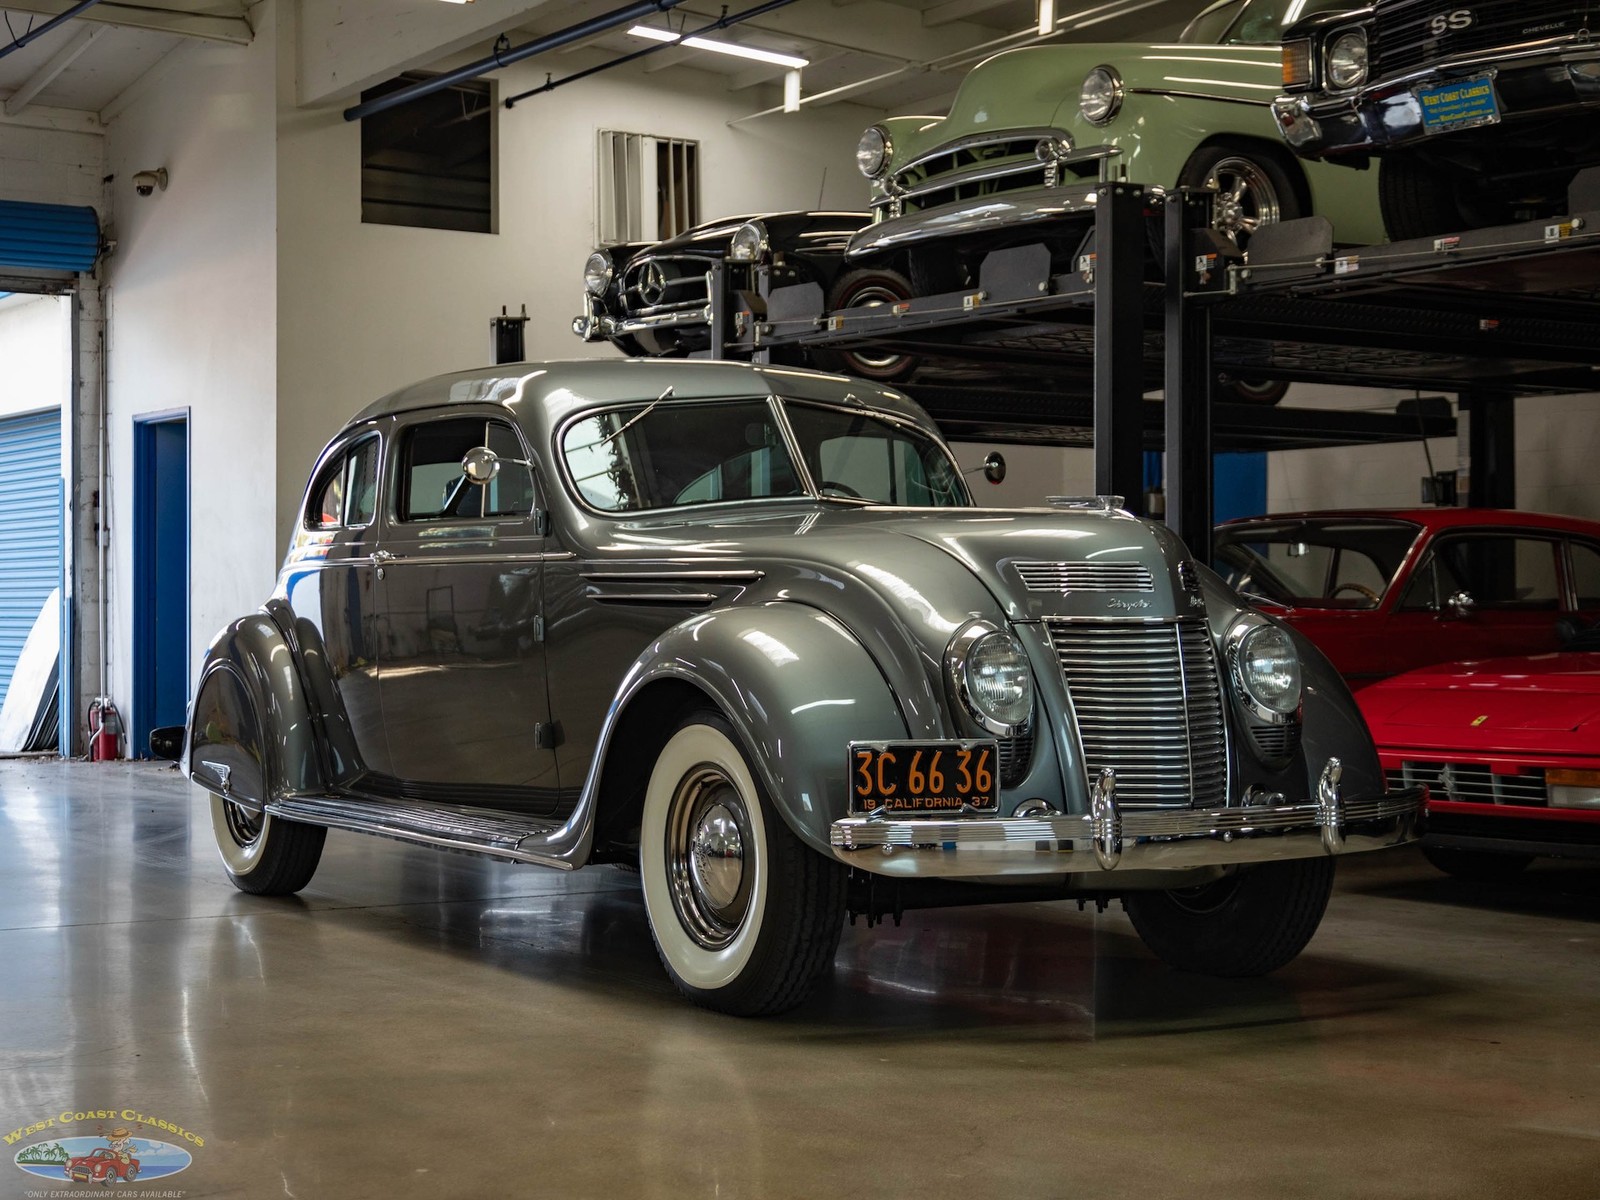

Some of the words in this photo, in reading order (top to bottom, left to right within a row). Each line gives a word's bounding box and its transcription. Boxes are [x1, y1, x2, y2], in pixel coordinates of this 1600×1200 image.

[1431, 9, 1473, 35] SS
[1522, 21, 1566, 34] CHEVELLE
[857, 751, 897, 795] 3C
[908, 750, 945, 795] 66
[956, 750, 992, 794] 36
[864, 799, 876, 810] 19
[884, 797, 963, 810] CALIFORNIA
[971, 796, 990, 807] 37
